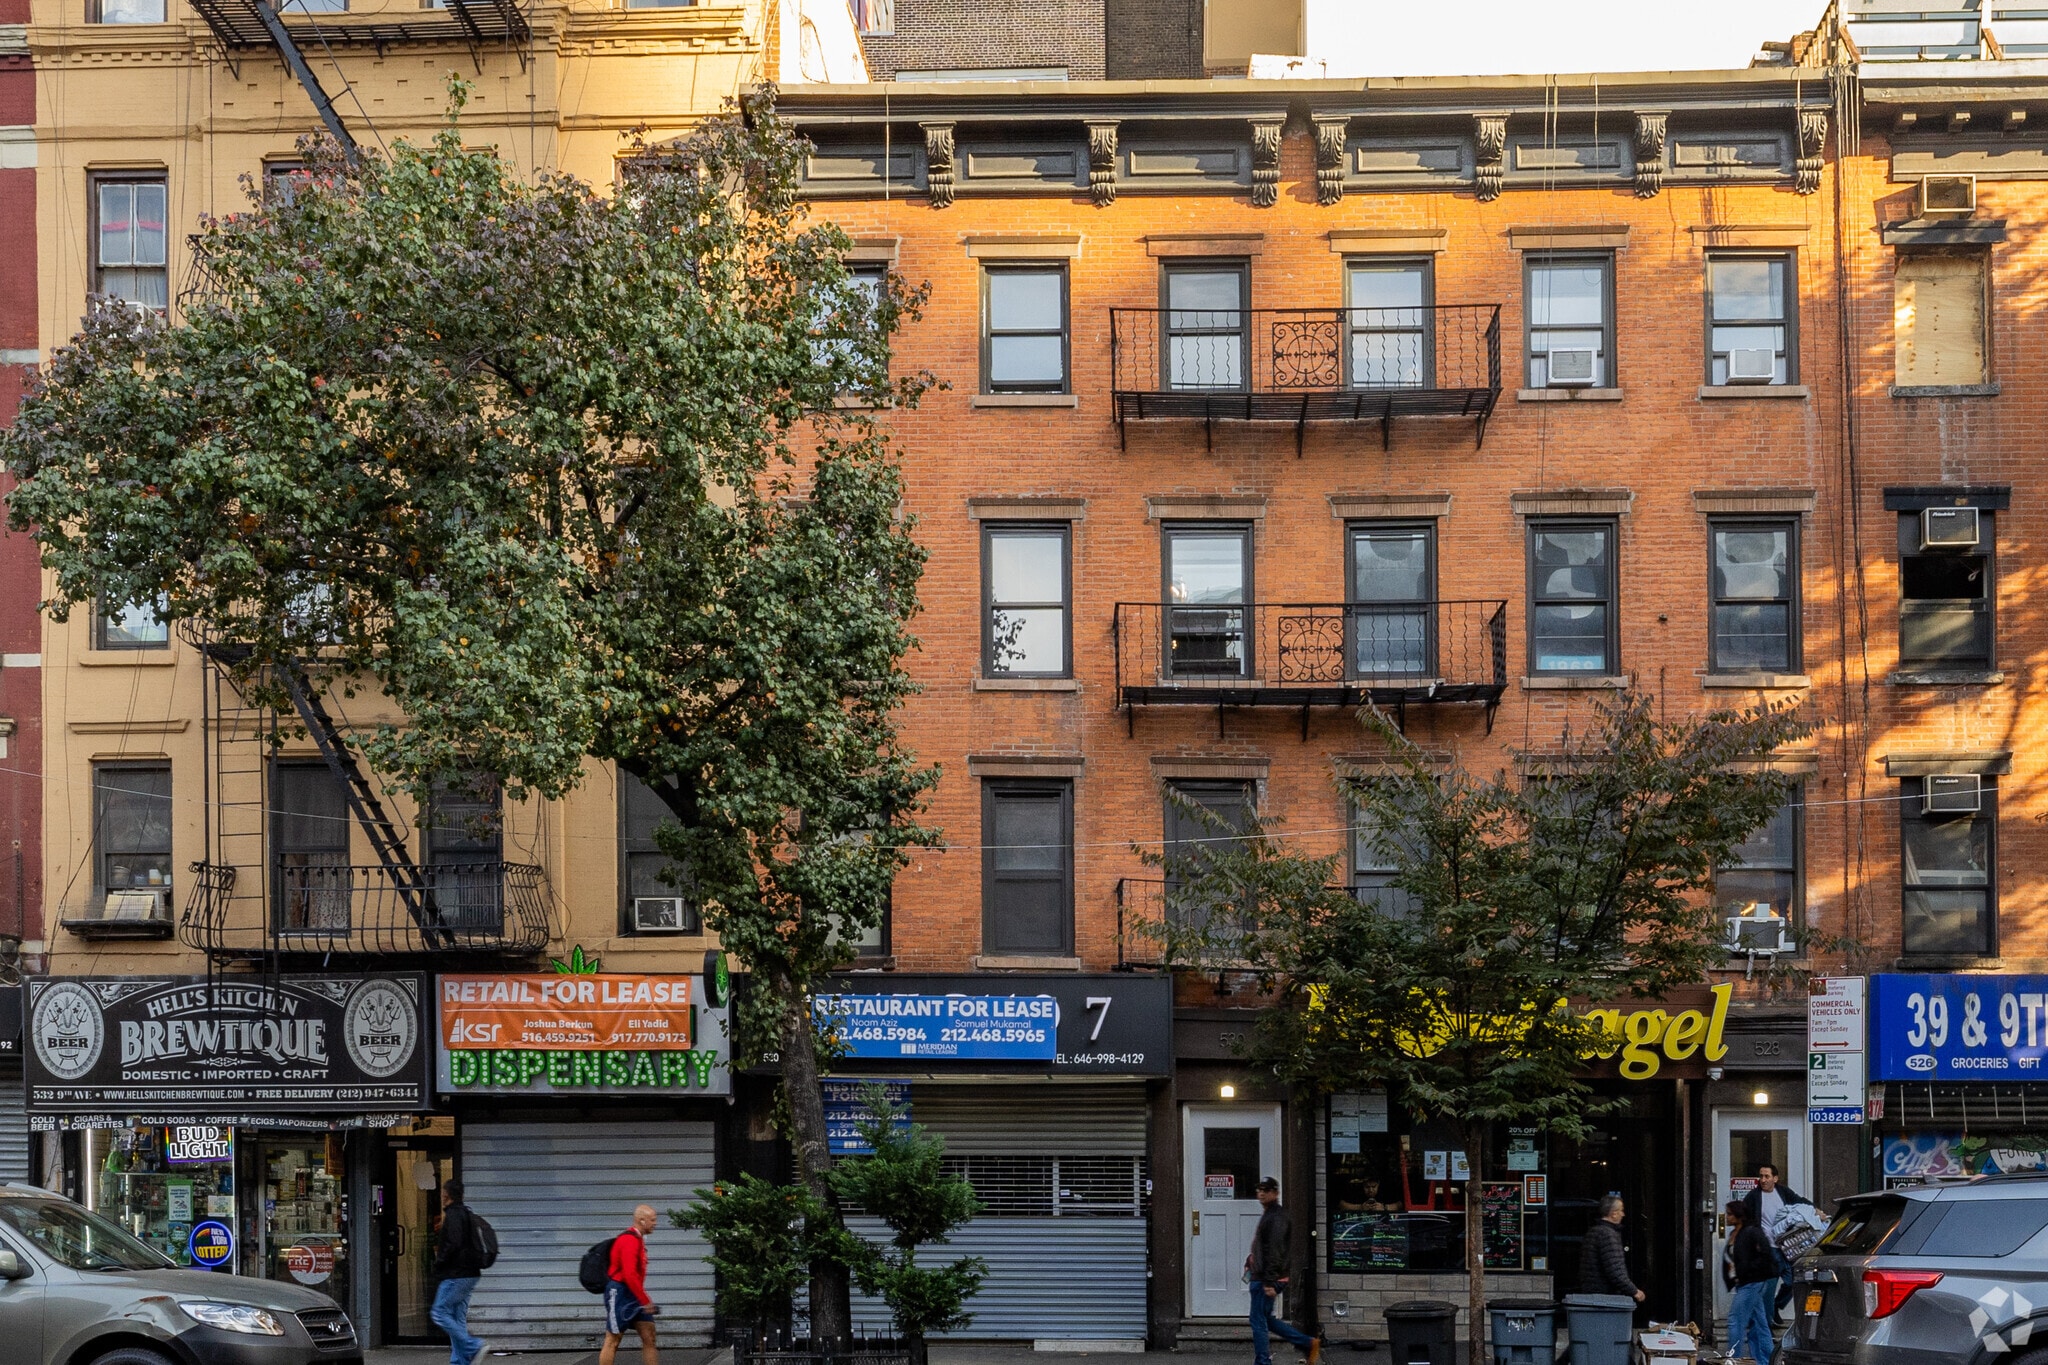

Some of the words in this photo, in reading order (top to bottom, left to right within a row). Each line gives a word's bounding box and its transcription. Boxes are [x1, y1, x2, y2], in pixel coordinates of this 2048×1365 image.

[444, 981, 535, 1004] RETAIL
[541, 981, 595, 1004] FOR
[602, 982, 686, 1004] LEASE
[146, 989, 208, 1018] HELL'S
[948, 1000, 989, 1017] FOR
[993, 1000, 1053, 1018] LEASE
[1811, 1000, 1854, 1008] COMMERCIAL
[851, 1018, 879, 1027] Noam
[880, 1018, 898, 1027] Aziz
[955, 1019, 988, 1028] Samuel
[990, 1019, 1032, 1029] Mukamal
[1086, 996, 1112, 1040] 7
[1907, 992, 1949, 1048] 39
[1961, 992, 1988, 1048] &
[523, 1019, 556, 1030] Joshua
[558, 1019, 593, 1030] Berkun
[628, 1019, 640, 1030] Eli
[642, 1019, 669, 1030] Yadid
[940, 1028, 1046, 1043] 212.468.5965
[1546, 983, 1733, 1080] agel
[47, 1037, 89, 1049] BEER
[119, 1018, 329, 1068] BREWTIQUE
[359, 1034, 401, 1047] BEER
[521, 1032, 595, 1044] 516.459.9251
[611, 1032, 687, 1044] 917.770.9173
[0, 1041, 13, 1049] 92
[917, 1043, 958, 1051] MERIDIAN
[1754, 1040, 1781, 1056] 528
[1813, 1054, 1823, 1069] 2
[1910, 1058, 1934, 1068] 526
[1951, 1057, 2009, 1069] GROCERIES
[2018, 1057, 2041, 1069] GIFT
[450, 1049, 717, 1087] DISPENSARY
[122, 1070, 191, 1080] DOMESTIC
[202, 1069, 272, 1080] IMPORTED
[282, 1069, 329, 1079] CRAFT
[33, 1090, 54, 1100] 532
[103, 1089, 245, 1100] WWW.HELLSKITCHENBREWTIQUE.COM
[256, 1089, 283, 1099] FREE
[284, 1089, 334, 1099] DELIVERY
[336, 1088, 363, 1100] (212)
[30, 1116, 56, 1124] COLD
[74, 1115, 105, 1123] CIGARS
[141, 1116, 166, 1124] COLD
[167, 1116, 196, 1124] SODAS
[205, 1116, 238, 1124] COFFEE
[365, 1112, 400, 1121] SMOKE
[1810, 1112, 1850, 1122] 103828
[30, 1123, 55, 1131] BEER
[71, 1120, 124, 1130] CIGARETTES
[368, 1119, 396, 1128] SHOP
[176, 1126, 219, 1143] BUD
[169, 1140, 228, 1159] LIGHT
